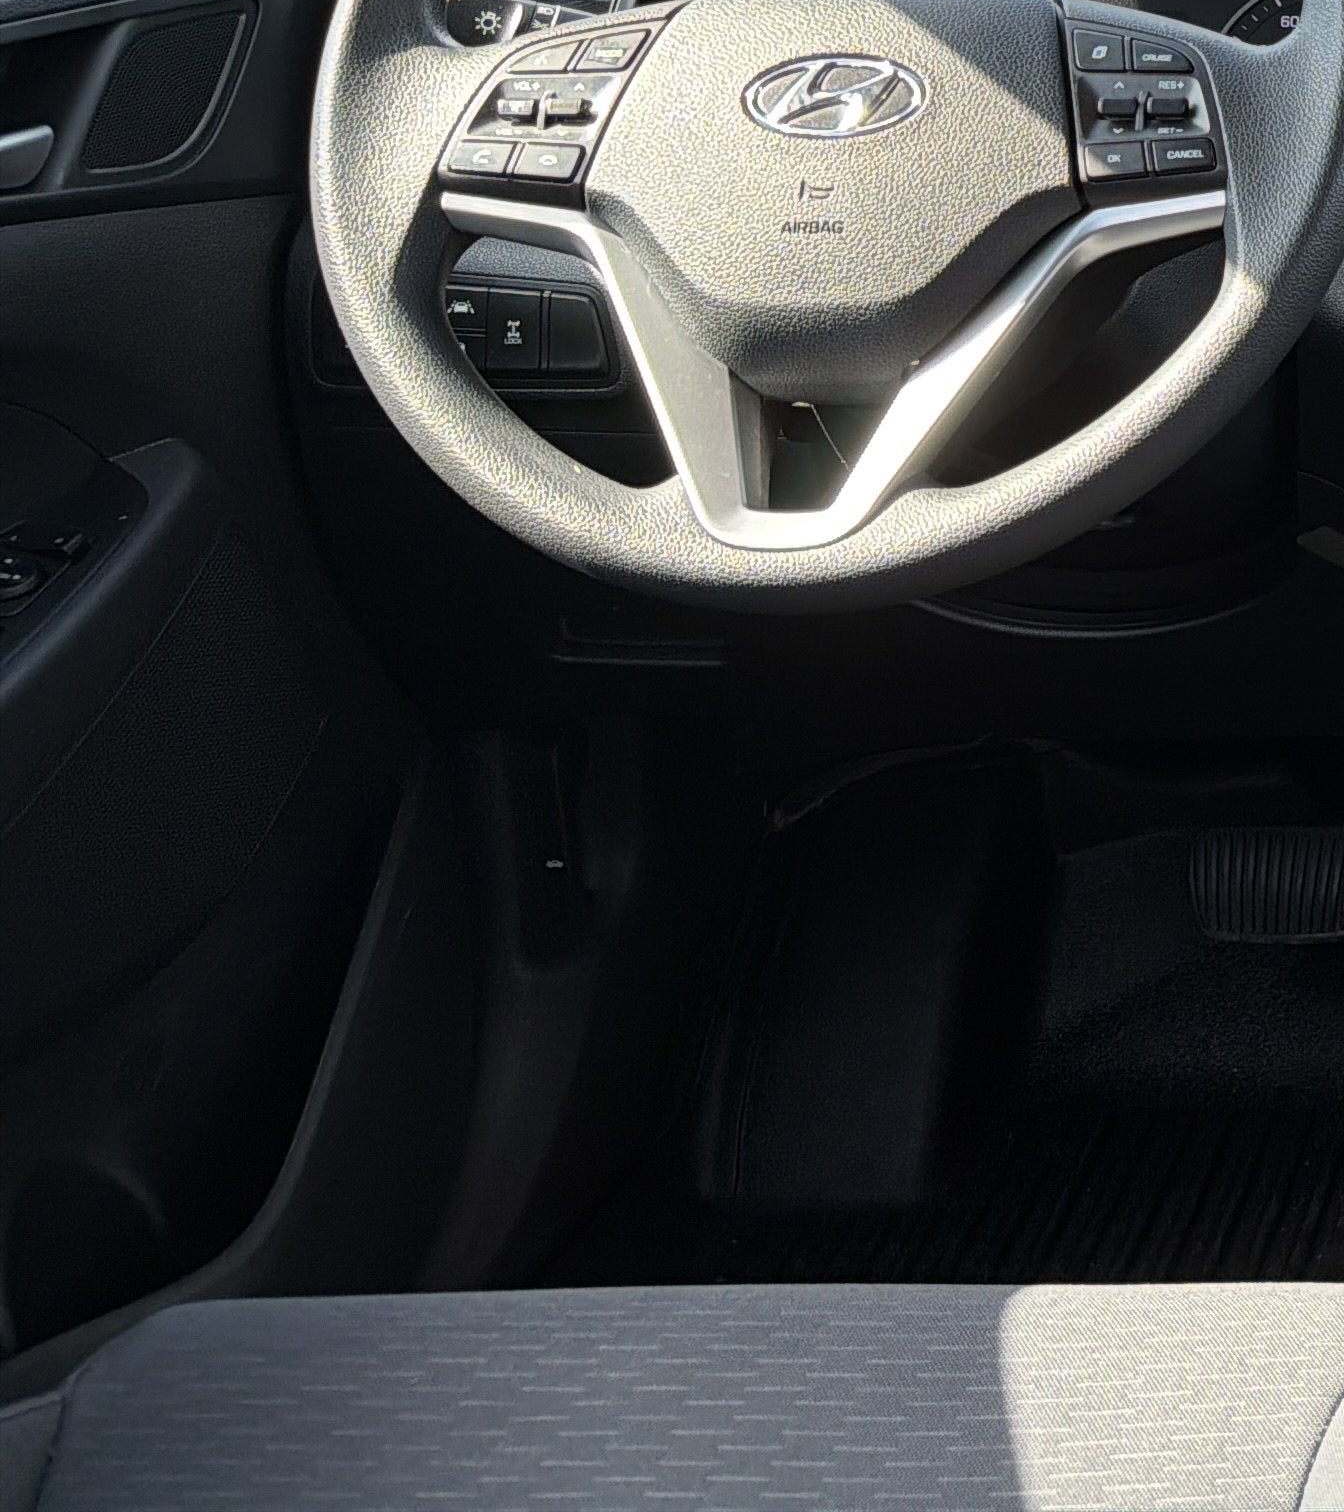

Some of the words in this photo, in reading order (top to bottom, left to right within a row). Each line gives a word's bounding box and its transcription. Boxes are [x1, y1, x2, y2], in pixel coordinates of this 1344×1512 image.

[1280, 15, 1299, 28] 60
[1141, 53, 1173, 62] CRUISE
[1107, 154, 1122, 163] OK
[1166, 149, 1204, 160] CANCEL
[781, 220, 845, 235] AIRBAG
